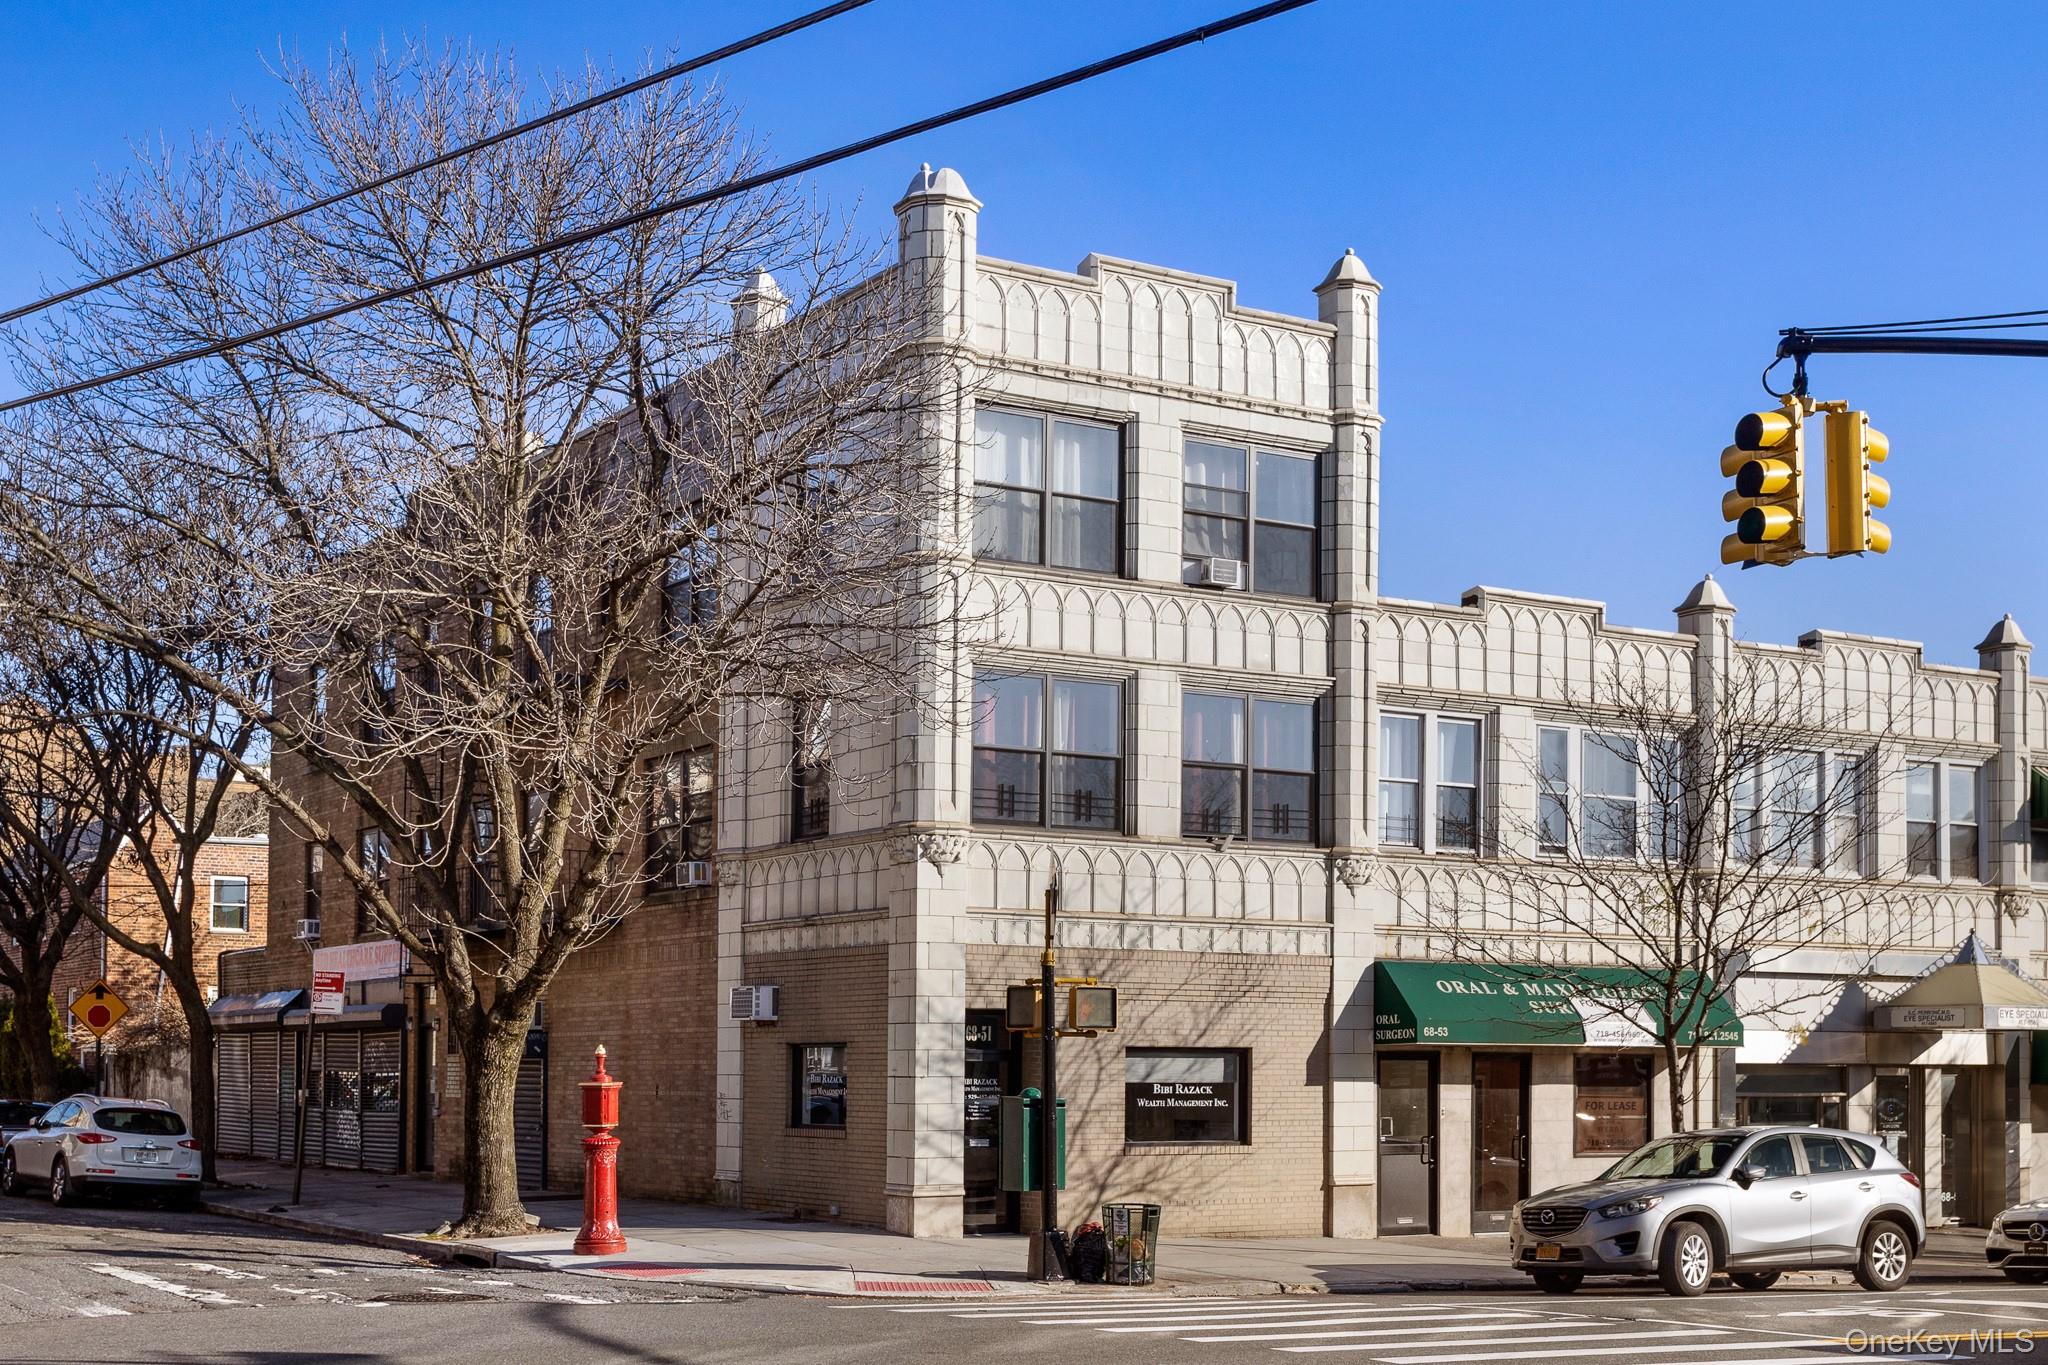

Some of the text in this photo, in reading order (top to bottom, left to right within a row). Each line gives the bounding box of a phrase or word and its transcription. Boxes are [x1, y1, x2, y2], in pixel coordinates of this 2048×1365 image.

[1435, 980, 1691, 1000] ORAL & MAXILOFACIL
[1918, 1014, 1955, 1022] SPECIALIST
[2000, 1009, 2015, 1019] EYE
[1376, 1014, 1401, 1025] ORAL
[1376, 1028, 1416, 1040] SURGEON
[1424, 1027, 1449, 1037] 68-53
[822, 1073, 843, 1084] RAZACK
[973, 1078, 998, 1086] RAZACK
[1153, 1083, 1213, 1095] BIBI RAZACK
[1137, 1098, 1229, 1107] WEALTH MANAGEMENT INC.
[1585, 1101, 1637, 1111] FOR LEASE
